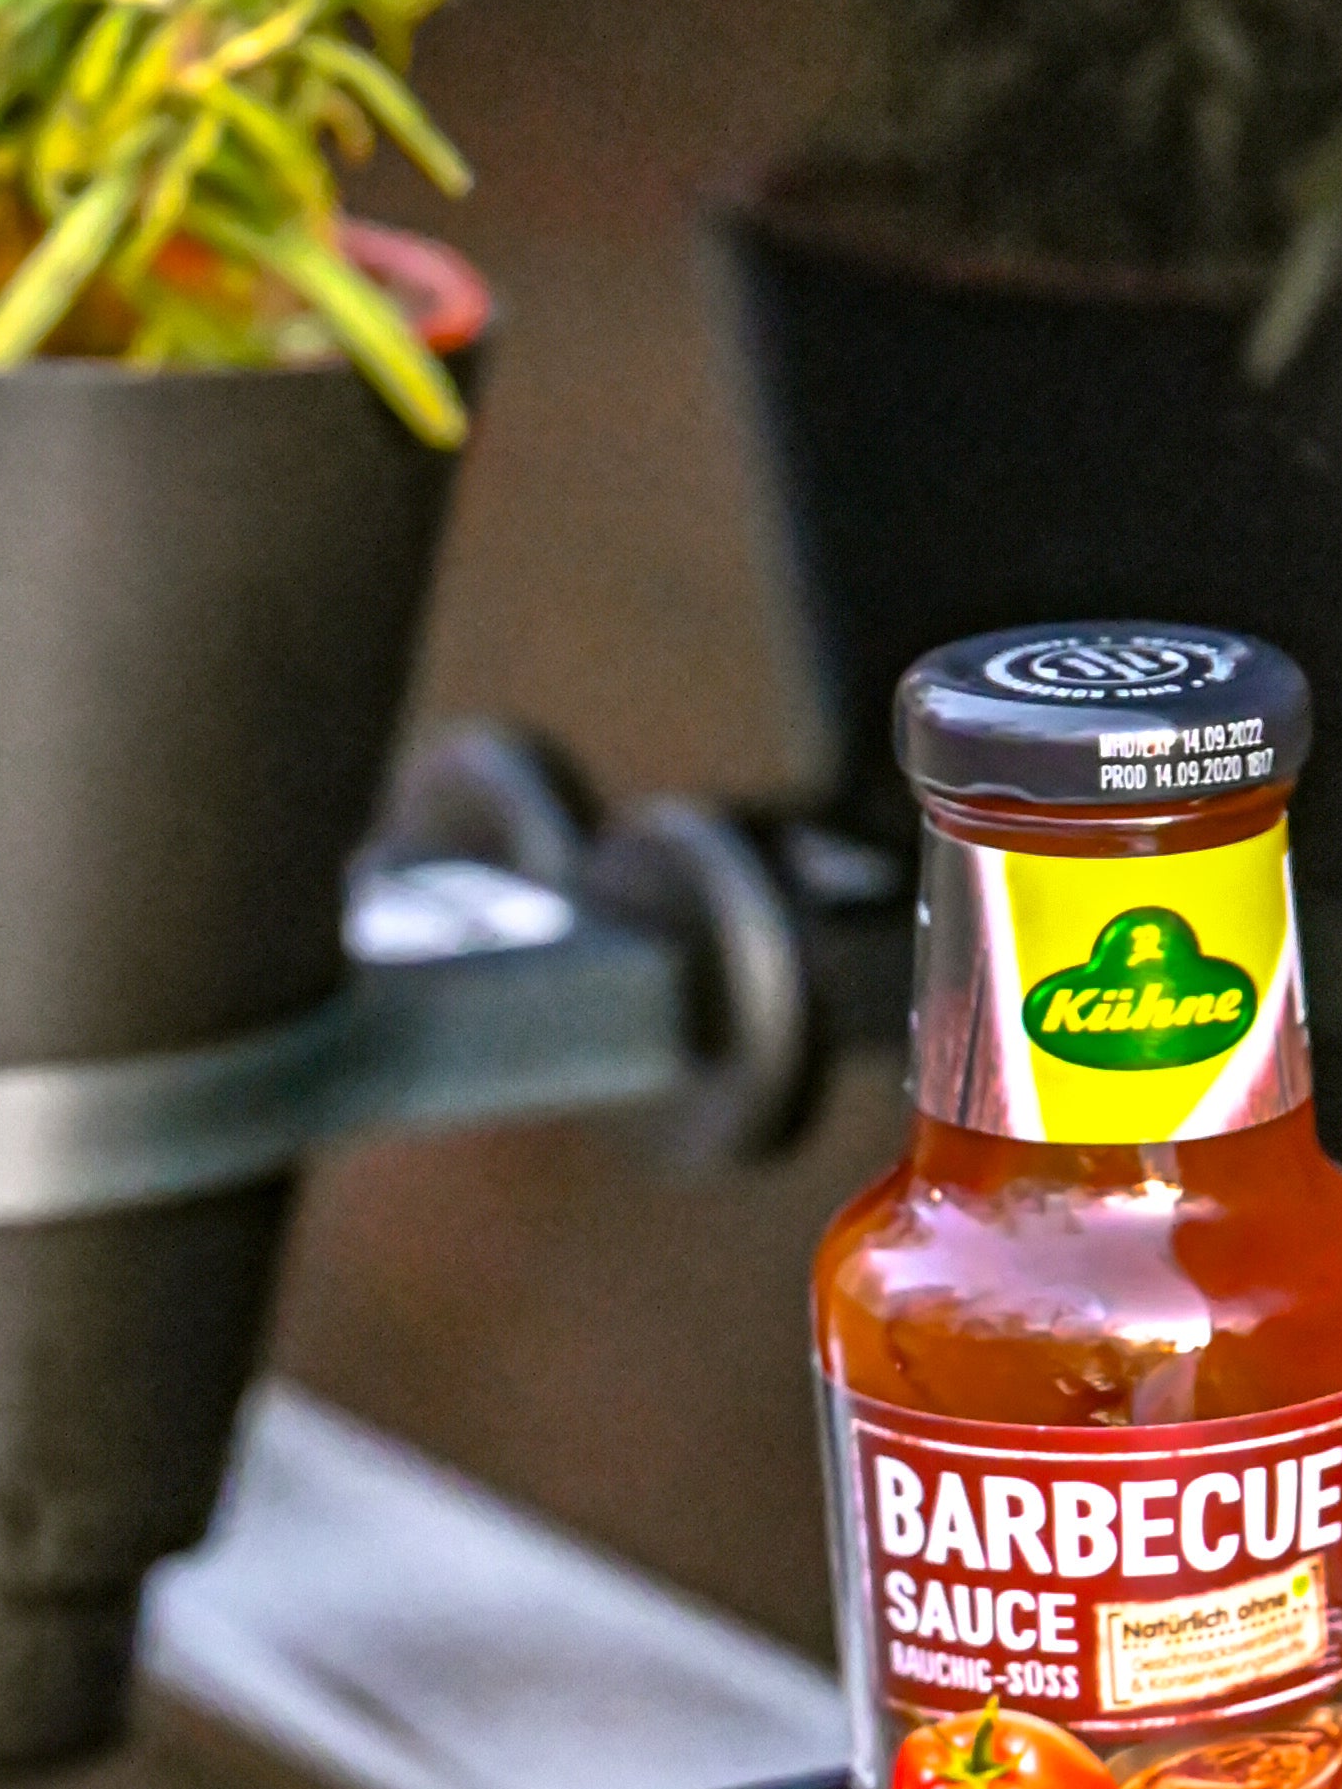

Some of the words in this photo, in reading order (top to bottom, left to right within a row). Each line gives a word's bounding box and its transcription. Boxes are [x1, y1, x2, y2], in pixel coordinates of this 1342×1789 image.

[1182, 718, 1264, 754] 14.09.2022
[1100, 763, 1147, 789] PROD
[1154, 754, 1242, 788] 14.09.2020
[1041, 983, 1243, 1033] Kühne
[884, 1570, 1079, 1653] SAUCE
[1122, 1607, 1228, 1639] Natürlich
[1237, 1593, 1287, 1620] ohne
